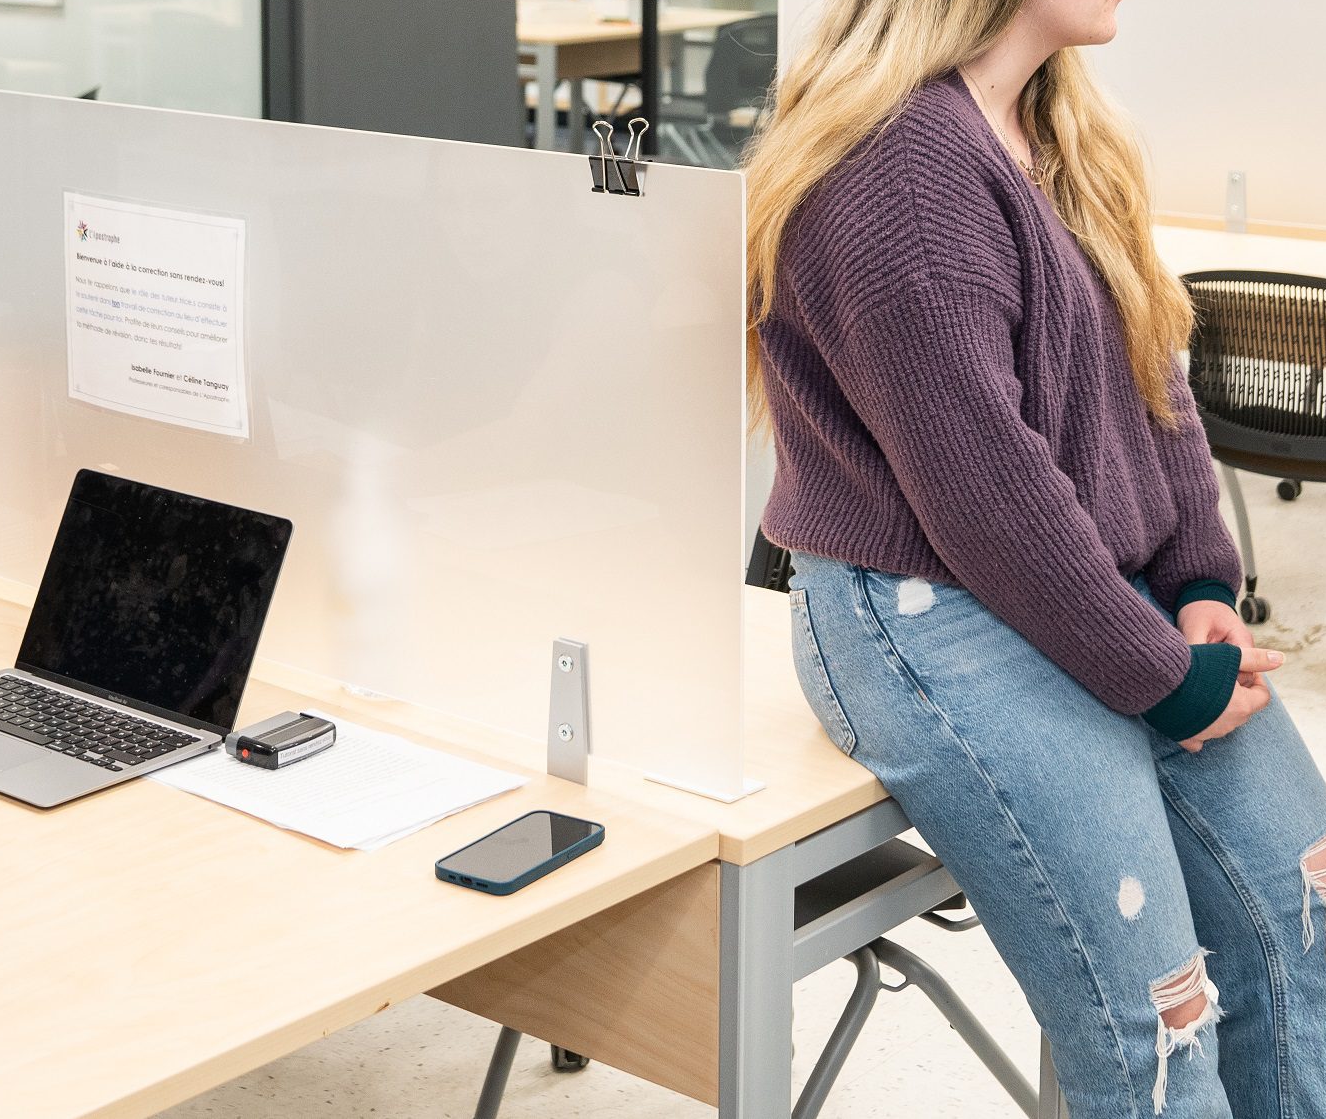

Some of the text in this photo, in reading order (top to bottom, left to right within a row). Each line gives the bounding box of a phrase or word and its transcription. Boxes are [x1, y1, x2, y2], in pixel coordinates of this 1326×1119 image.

[76, 252, 103, 265] Bienvenue
[138, 266, 169, 278] correction
[170, 271, 183, 281] sans
